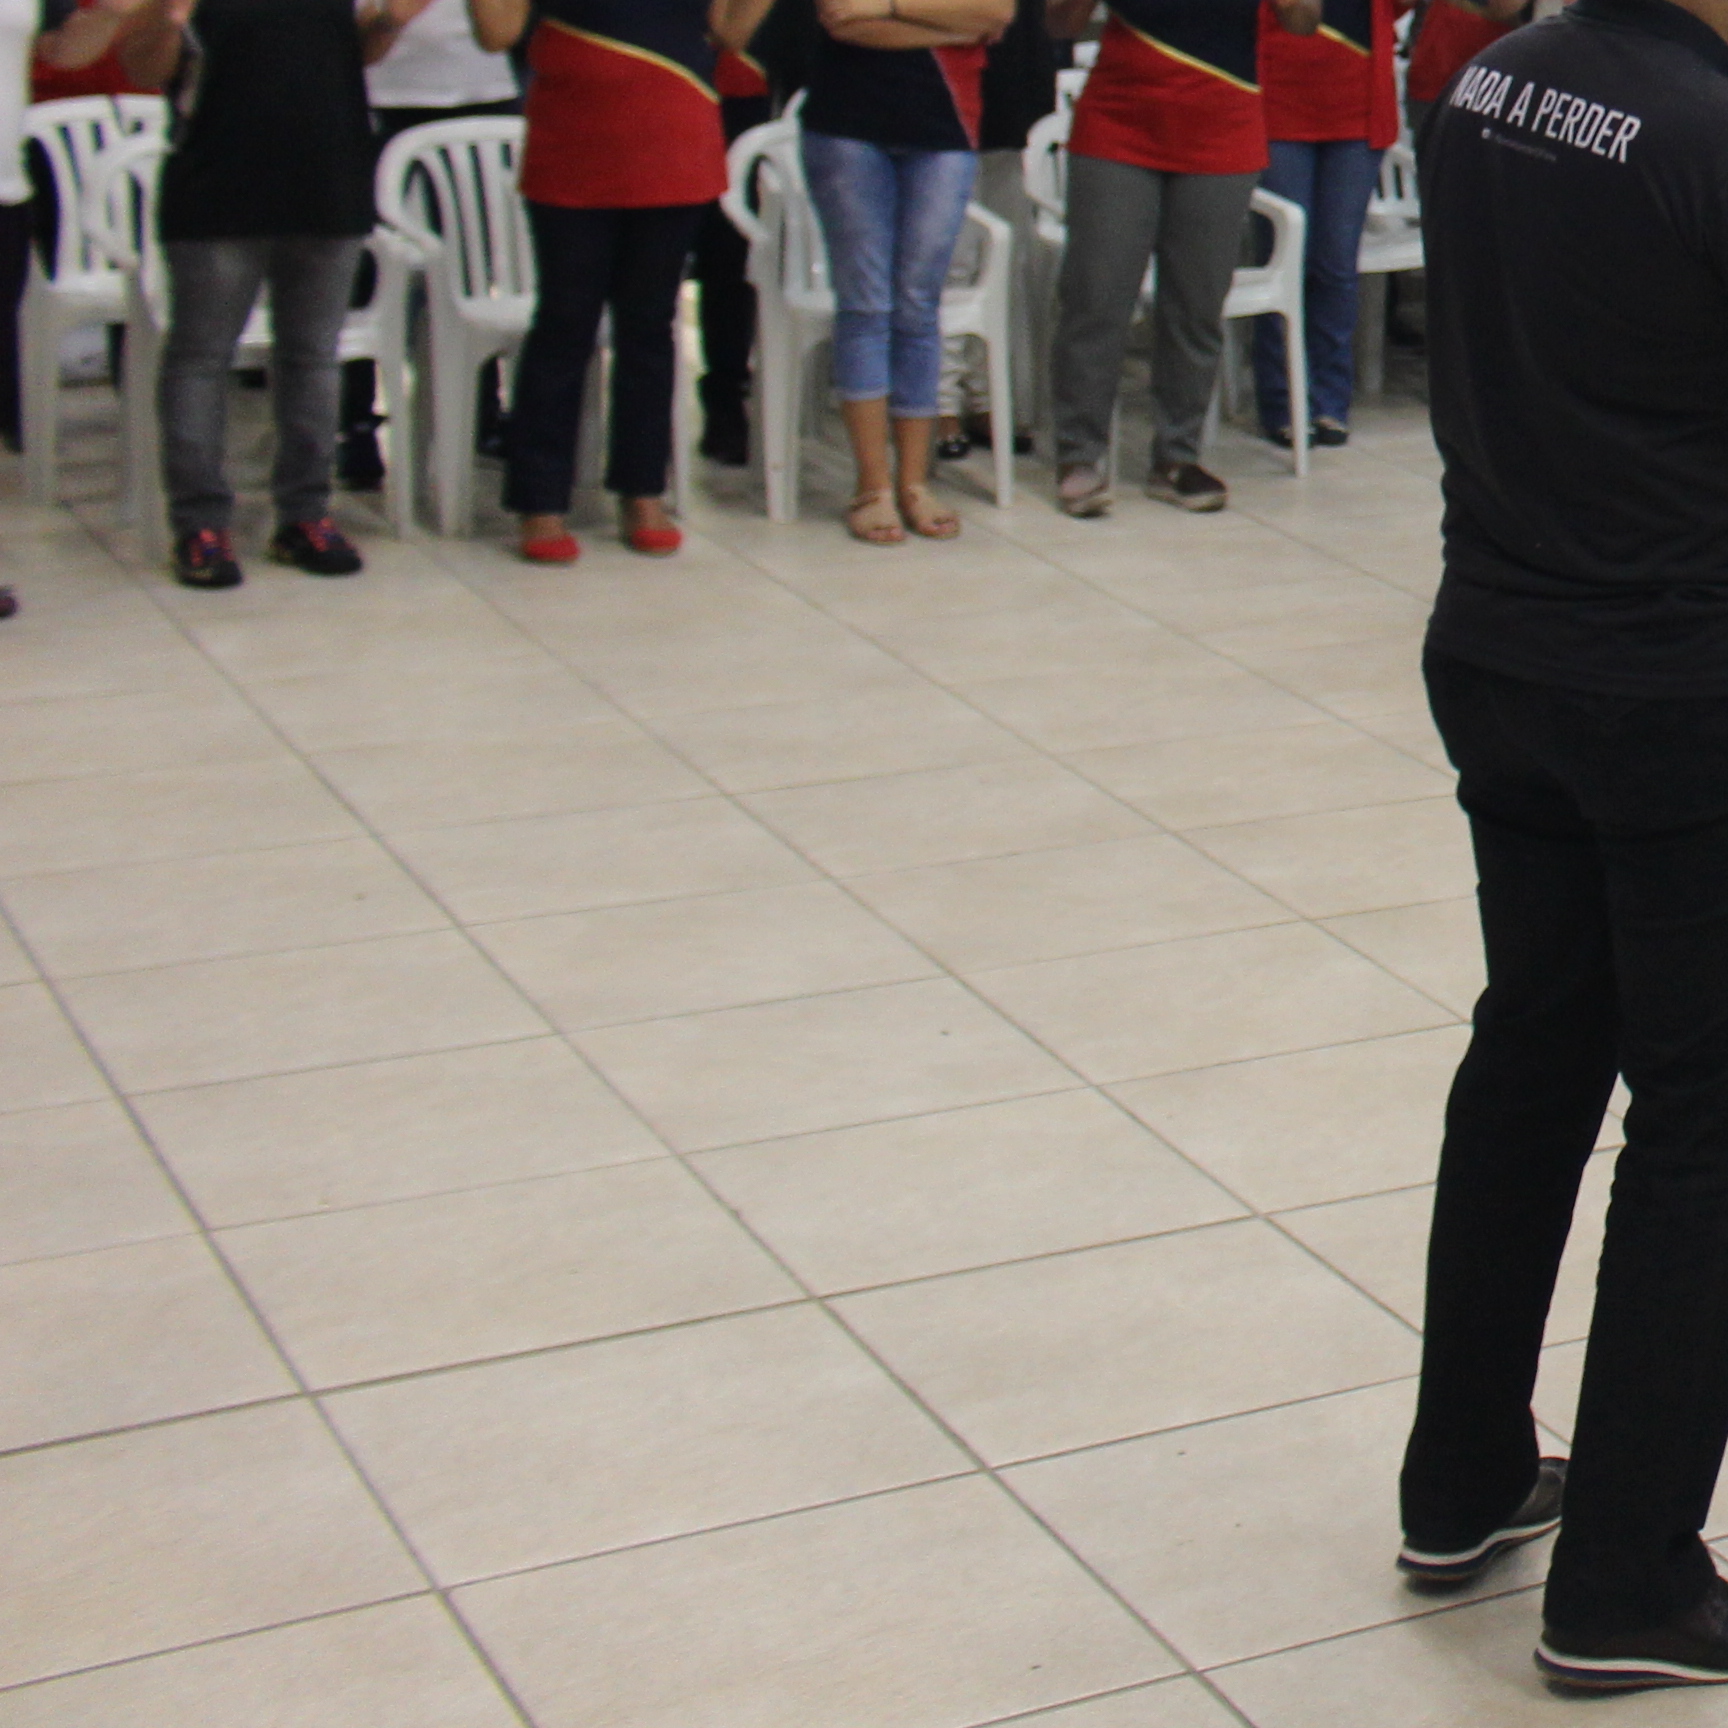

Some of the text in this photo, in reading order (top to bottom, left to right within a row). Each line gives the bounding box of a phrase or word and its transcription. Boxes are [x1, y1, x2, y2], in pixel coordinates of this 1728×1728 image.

[1450, 65, 1513, 119] NADA
[1507, 81, 1535, 128] A
[1531, 87, 1642, 164] PERDER
